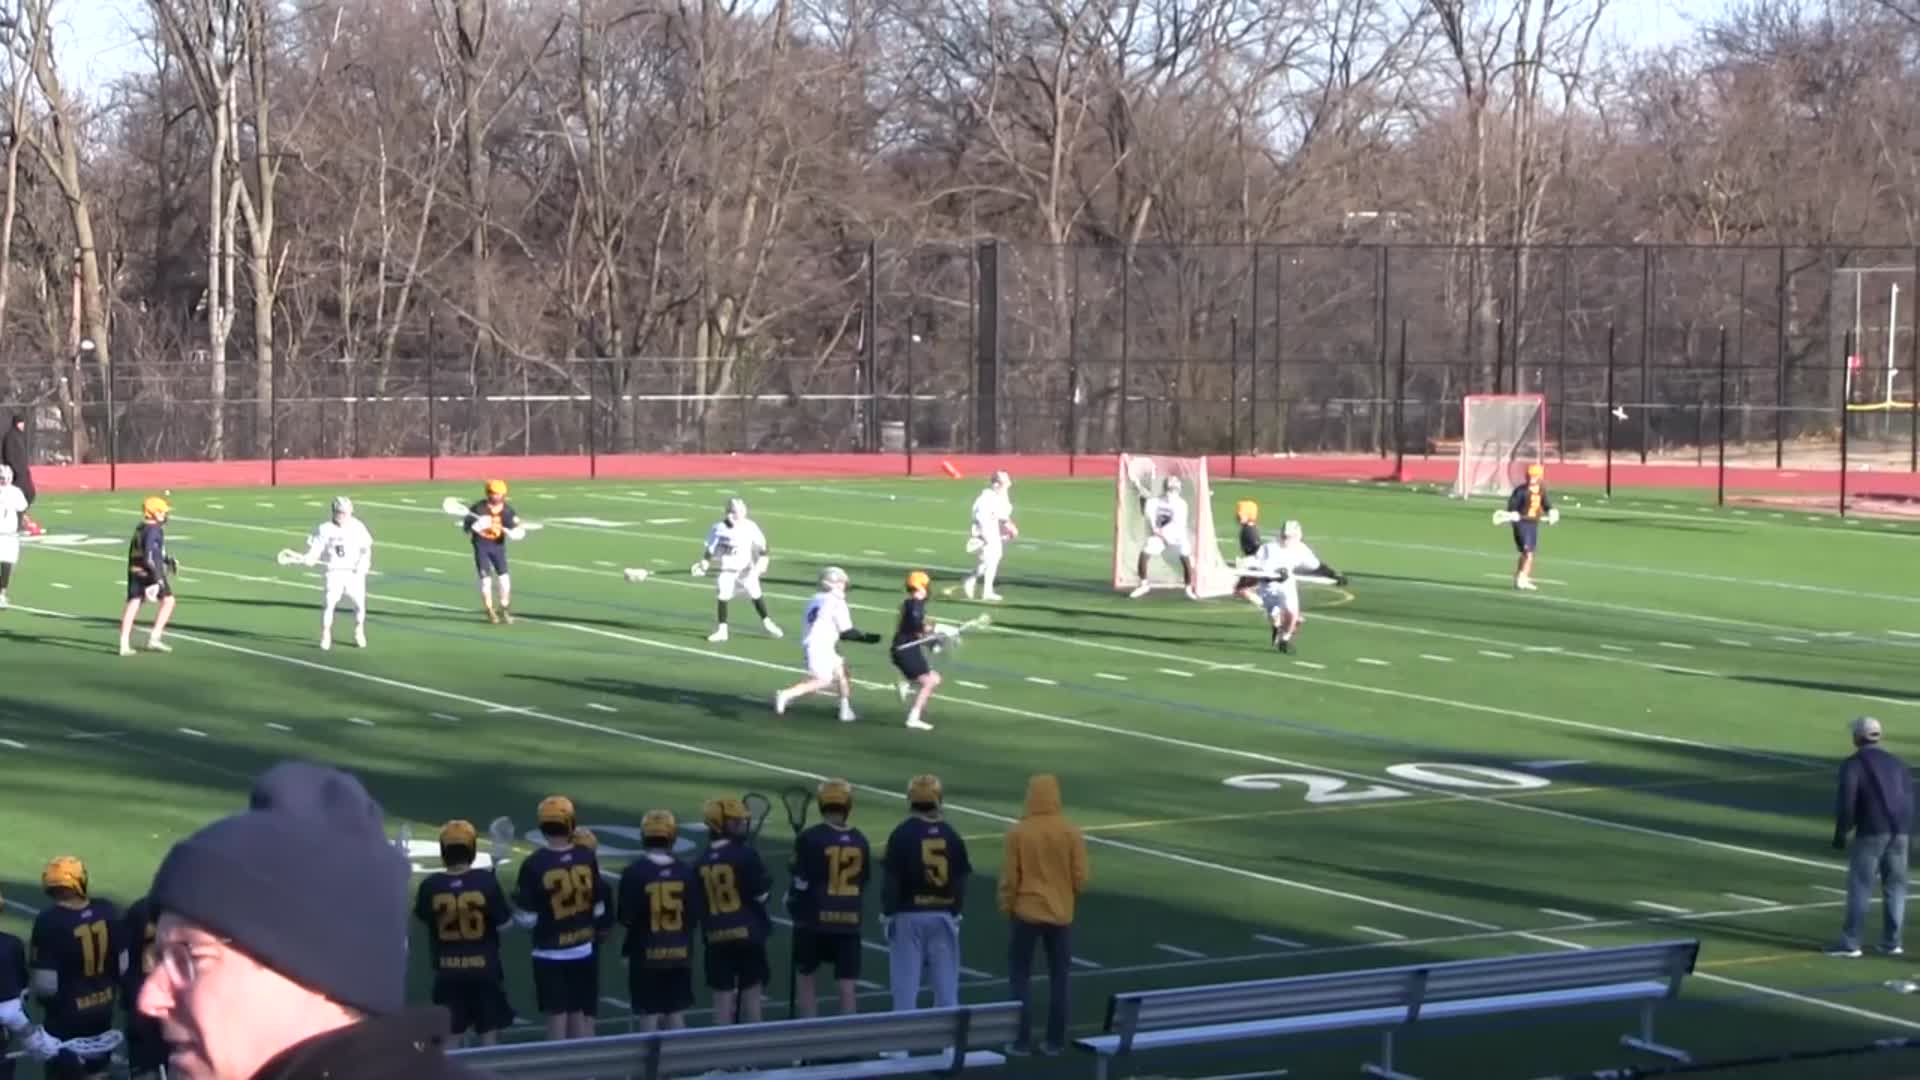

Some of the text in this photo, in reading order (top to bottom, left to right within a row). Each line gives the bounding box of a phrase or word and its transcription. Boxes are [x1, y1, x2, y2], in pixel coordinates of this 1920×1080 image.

[1222, 762, 1551, 803] 20
[824, 846, 863, 896] 12
[922, 838, 949, 887] 5
[645, 881, 685, 932] 15
[700, 864, 742, 915] 18
[432, 891, 487, 940] 26
